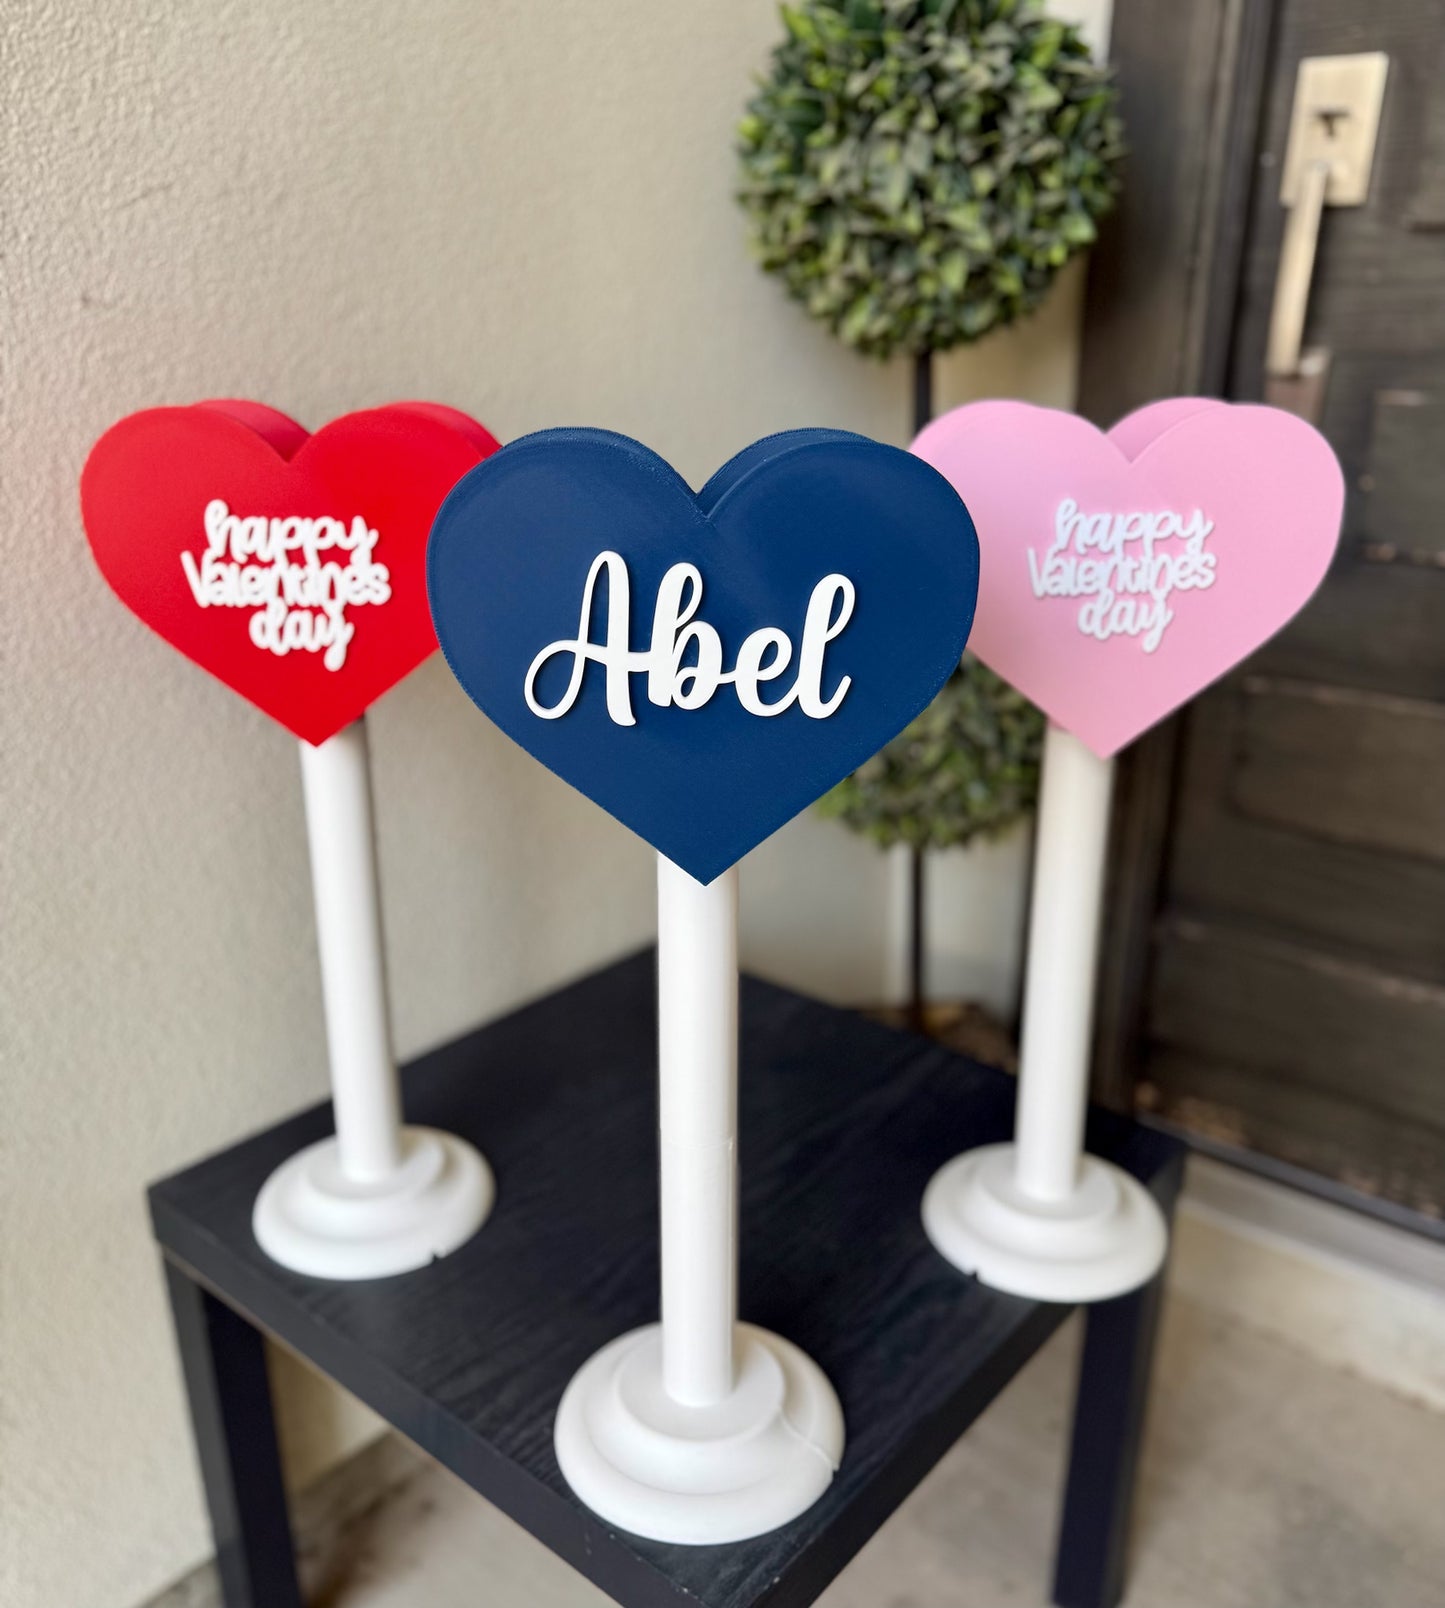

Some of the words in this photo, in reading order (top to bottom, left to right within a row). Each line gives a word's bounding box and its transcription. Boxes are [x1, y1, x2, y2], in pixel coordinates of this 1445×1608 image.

[204, 499, 379, 566] happy
[1055, 497, 1215, 556] happy
[249, 597, 355, 672] day
[524, 550, 856, 727] Abel
[1077, 587, 1175, 654] day
